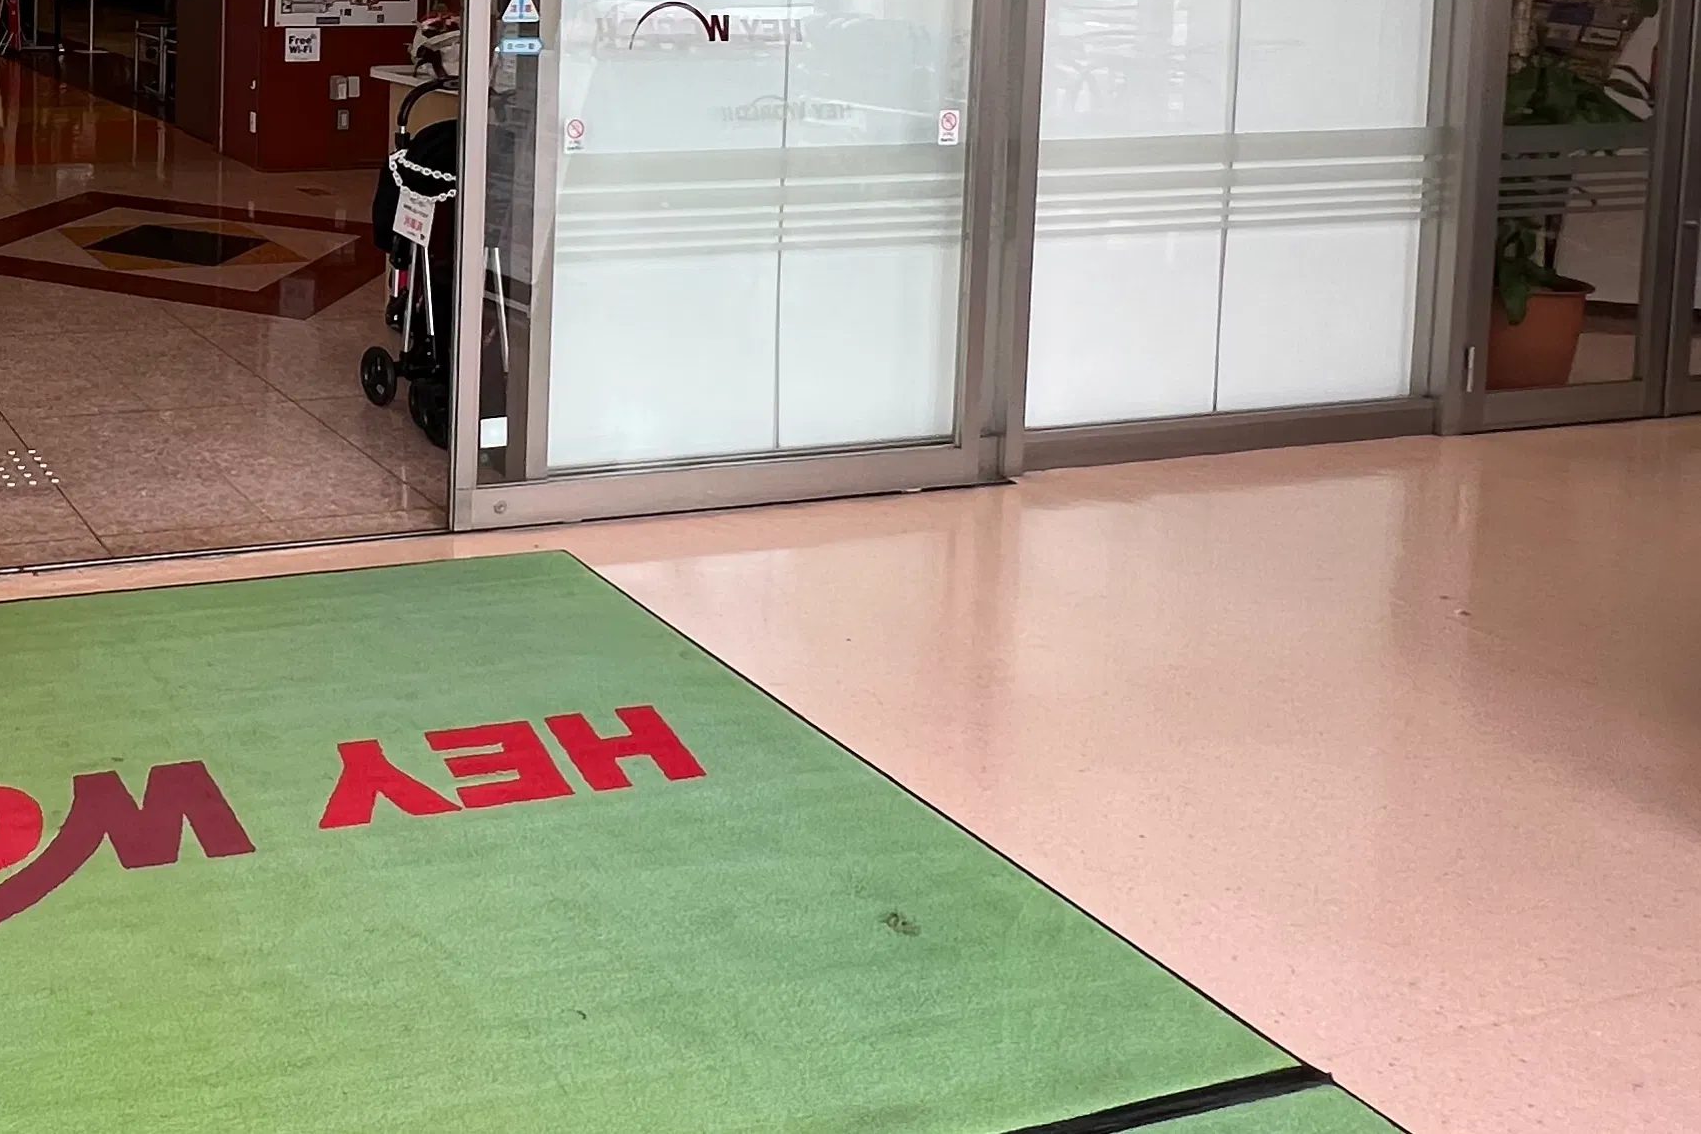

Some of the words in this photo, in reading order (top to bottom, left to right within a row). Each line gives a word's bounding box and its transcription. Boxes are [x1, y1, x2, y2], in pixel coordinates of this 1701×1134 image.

[288, 35, 312, 45] Free
[289, 45, 313, 54] Wi-Fi
[318, 704, 708, 829] HEY
